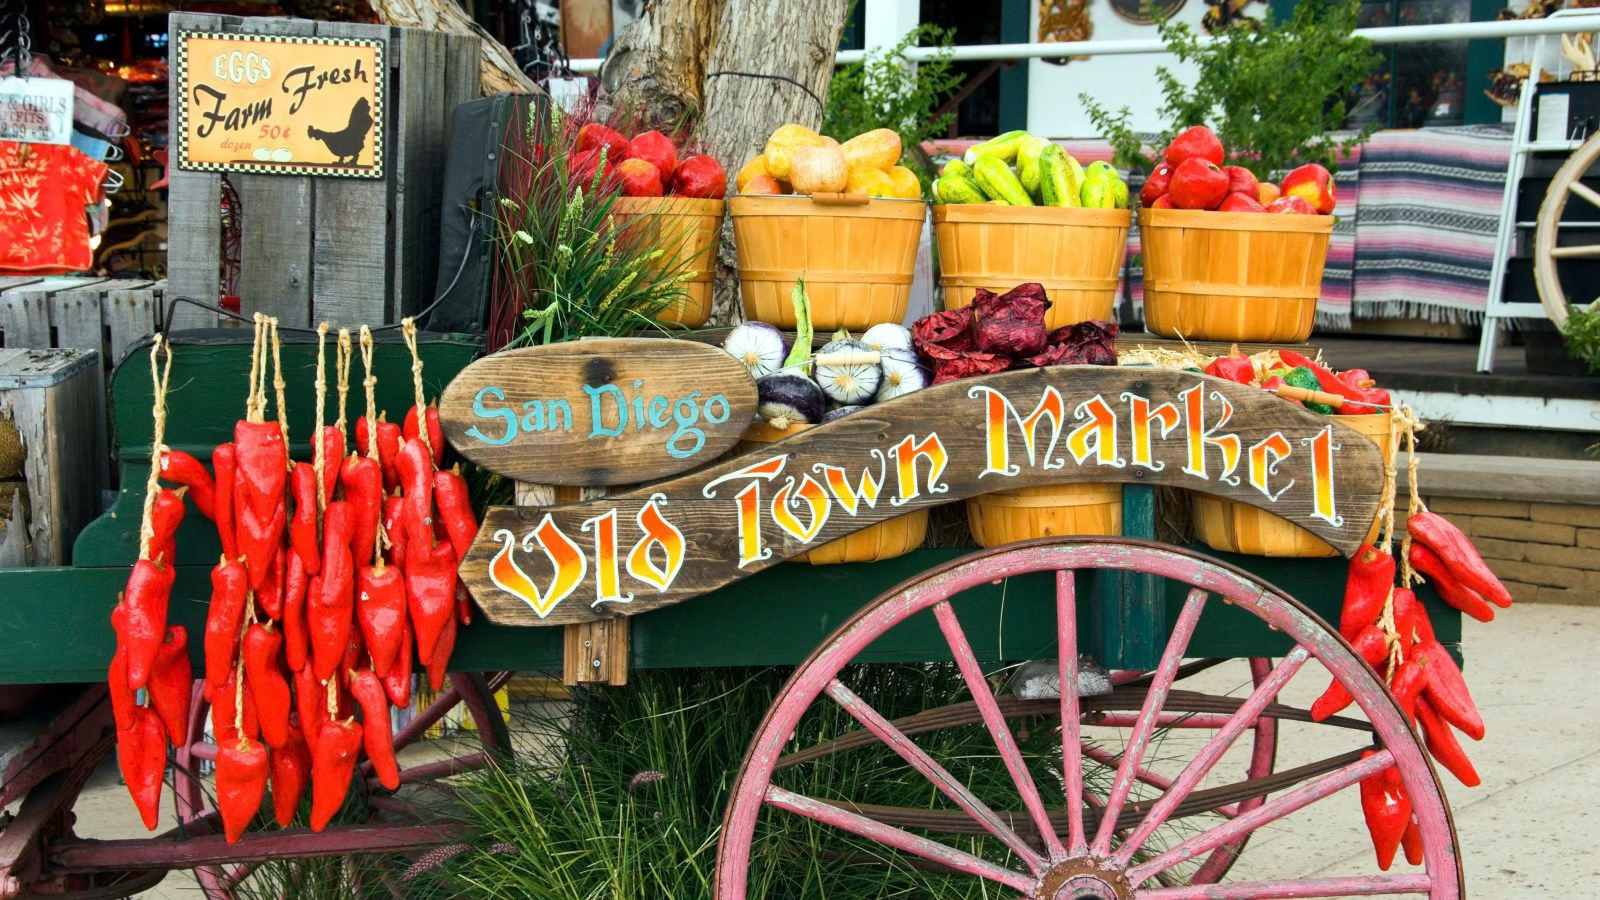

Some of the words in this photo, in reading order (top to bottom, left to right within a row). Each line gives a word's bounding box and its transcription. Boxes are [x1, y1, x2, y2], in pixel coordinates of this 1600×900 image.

[214, 50, 272, 84] EGGS
[23, 95, 67, 115] GIRLS
[193, 83, 273, 138] Farm
[281, 59, 368, 115] Fresh
[220, 138, 252, 151] dozen
[258, 124, 291, 140] 50¢
[465, 385, 573, 446] San
[582, 379, 731, 459] Diego
[488, 492, 687, 619] Old
[702, 431, 949, 570] Town
[968, 380, 1344, 528] Market
